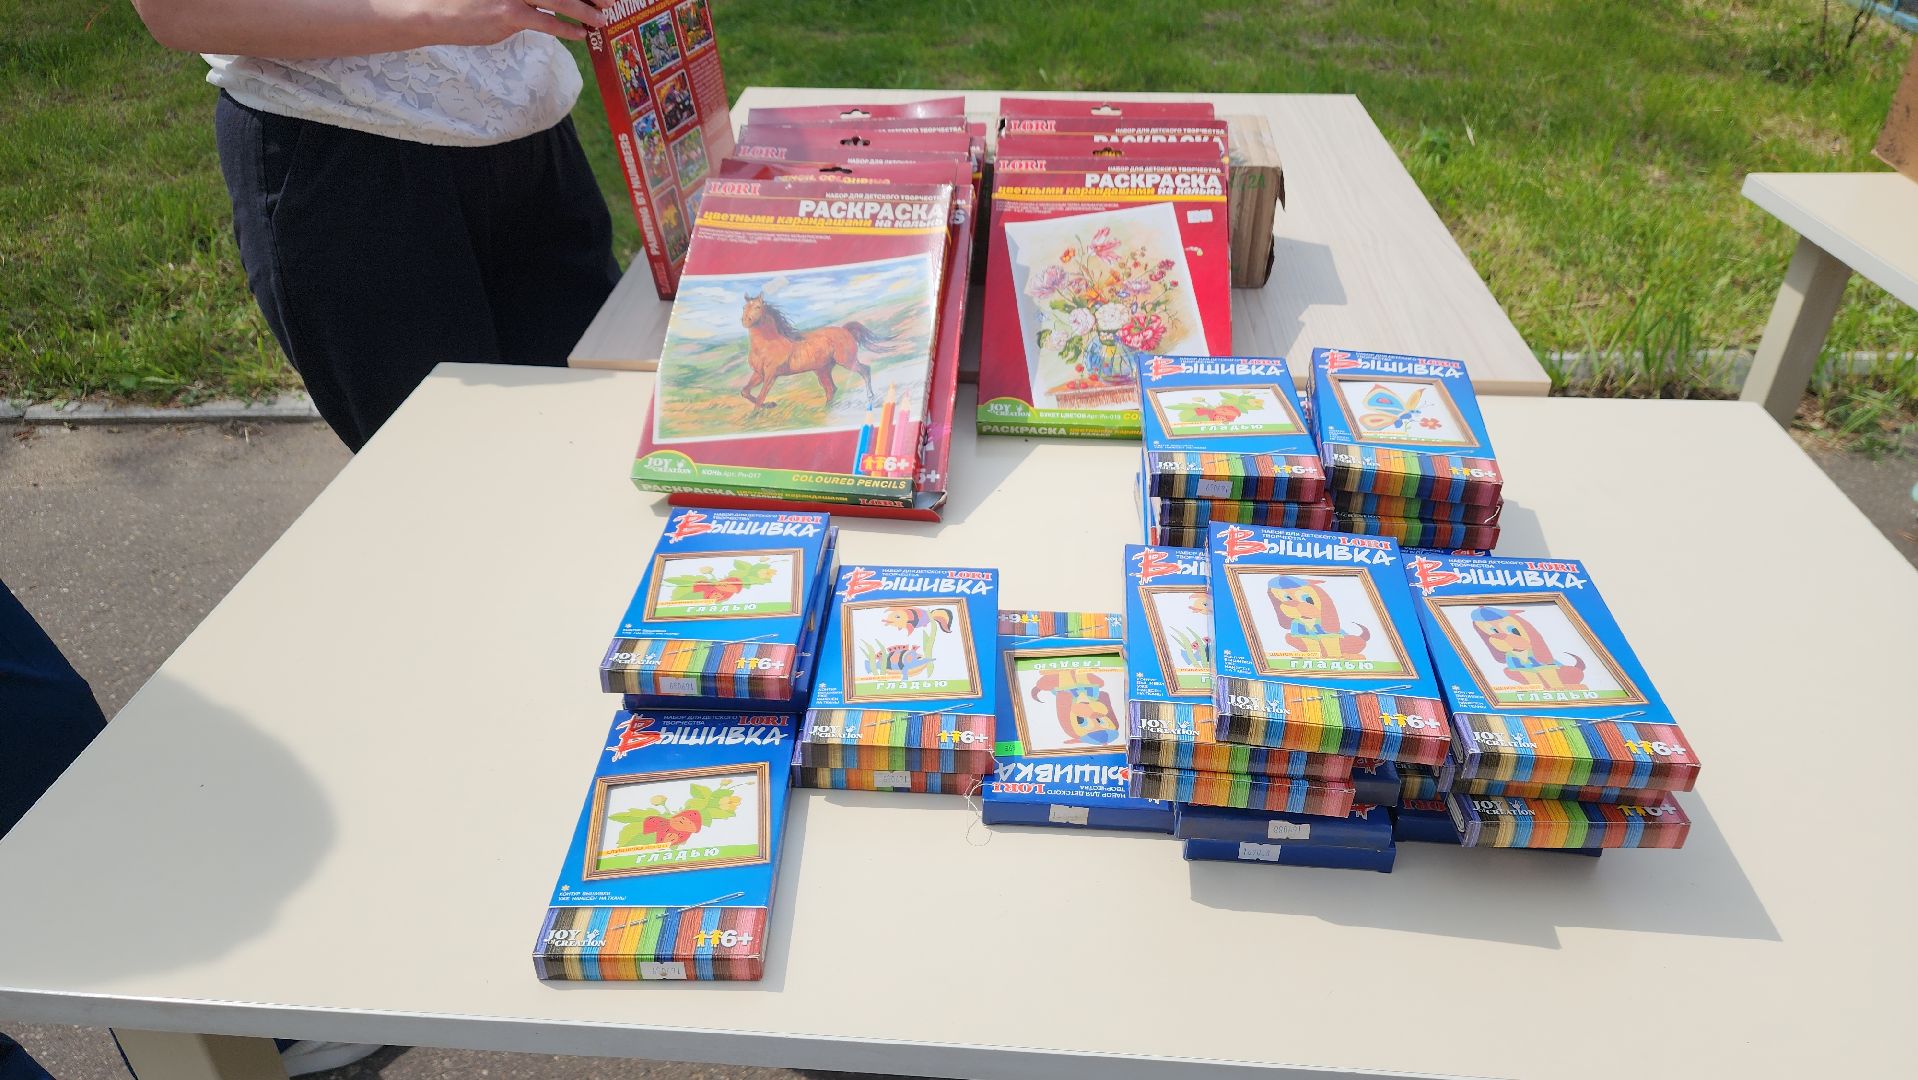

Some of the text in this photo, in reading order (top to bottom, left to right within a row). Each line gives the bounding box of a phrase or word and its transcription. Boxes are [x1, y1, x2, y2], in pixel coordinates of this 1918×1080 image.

[1010, 120, 1056, 132] LORI
[999, 160, 1046, 172] LORI
[1085, 173, 1223, 188] РАСКРАСКА
[710, 182, 760, 195] LORI
[799, 199, 945, 220] РАСКРАСКА
[1143, 356, 1285, 382] ВЫШИВКА
[1319, 350, 1465, 378] ВЫШИВКА
[988, 403, 1012, 413] JOY
[982, 425, 1067, 435] РАСКРАСКА
[644, 457, 672, 468] JOY
[883, 456, 909, 473] 6+
[1292, 466, 1318, 474] 6+
[1470, 468, 1496, 479] 6+
[791, 474, 907, 489] COLOURED PENCILS
[640, 483, 736, 496] РАСКРАСКА
[777, 514, 823, 524] LORI
[664, 510, 821, 544] ВЫШИВКА
[1214, 525, 1397, 566] ВЫШИВКА
[1337, 536, 1392, 550] LORI
[1525, 562, 1580, 573] LORI
[947, 570, 993, 580] LORI
[1406, 555, 1588, 596] ВЫШИВКА
[836, 567, 994, 602] ВЫШИВКА
[686, 603, 757, 613] гладью
[609, 652, 641, 662] JOY
[758, 657, 785, 670] 6+
[1289, 659, 1374, 671] гладью
[876, 680, 948, 689] гладью
[1227, 694, 1261, 707] JOY
[1516, 690, 1599, 702] гладью
[737, 715, 789, 726] LORI
[1138, 718, 1171, 729] JOY
[1407, 712, 1441, 729] 6+
[809, 725, 840, 735] JOY
[1473, 731, 1505, 741] JOY
[606, 713, 788, 762] ВЫШИВКА
[960, 731, 989, 743] 6+
[1652, 741, 1686, 756] 6+
[994, 763, 1131, 785] ЫШИВКА
[992, 782, 1046, 794] LORI
[1472, 801, 1504, 811] JOY
[635, 847, 720, 864] гладью
[544, 929, 581, 942] JOY
[720, 928, 753, 947] 6+
